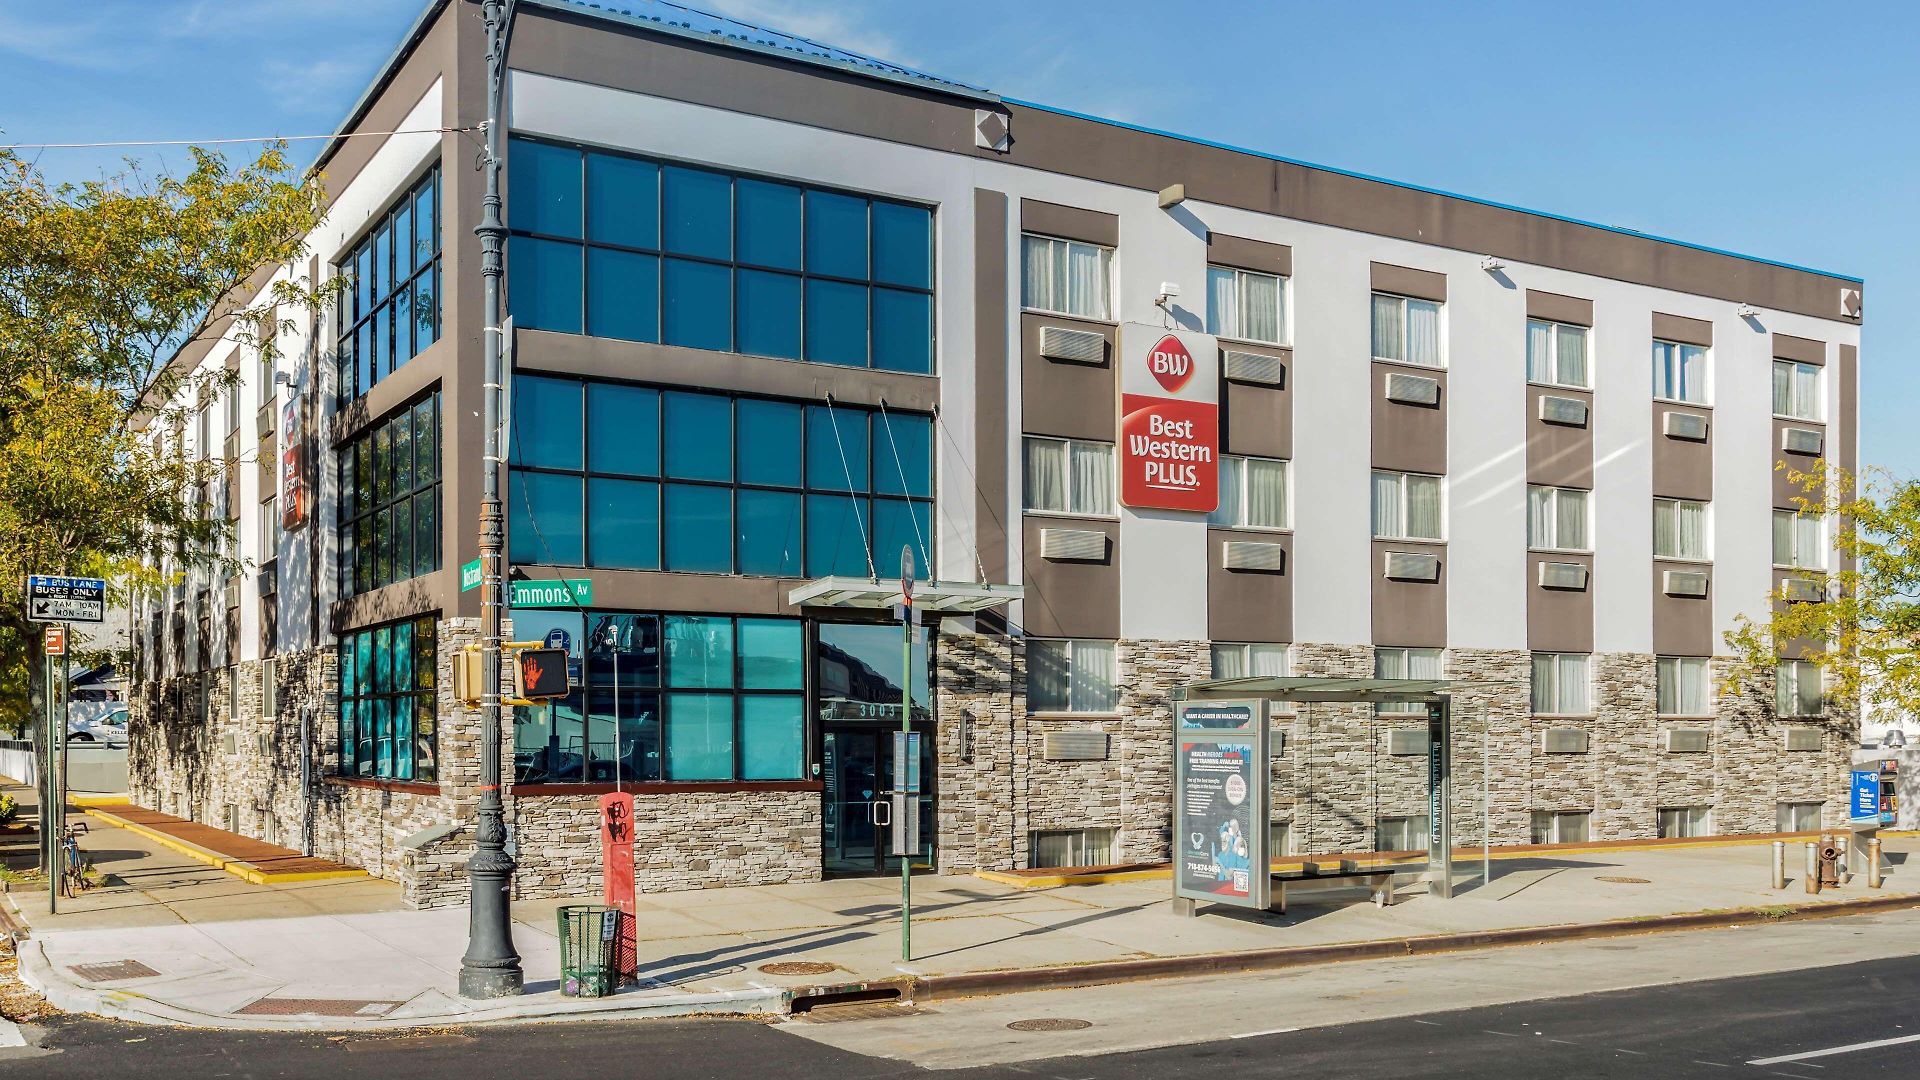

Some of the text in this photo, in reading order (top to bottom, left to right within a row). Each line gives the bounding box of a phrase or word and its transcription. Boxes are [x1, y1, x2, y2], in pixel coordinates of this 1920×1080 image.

[1154, 352, 1188, 376] BW
[1150, 414, 1194, 439] Best
[1130, 435, 1211, 463] Western
[52, 579, 98, 589] BUS LANE
[36, 586, 98, 597] BUSES ONLY
[509, 583, 588, 604] Emmons Av
[54, 600, 72, 608] 7AM
[79, 601, 99, 610] 10AM
[55, 609, 75, 617] MON
[82, 610, 97, 618] FRI
[860, 704, 896, 717] 3003
